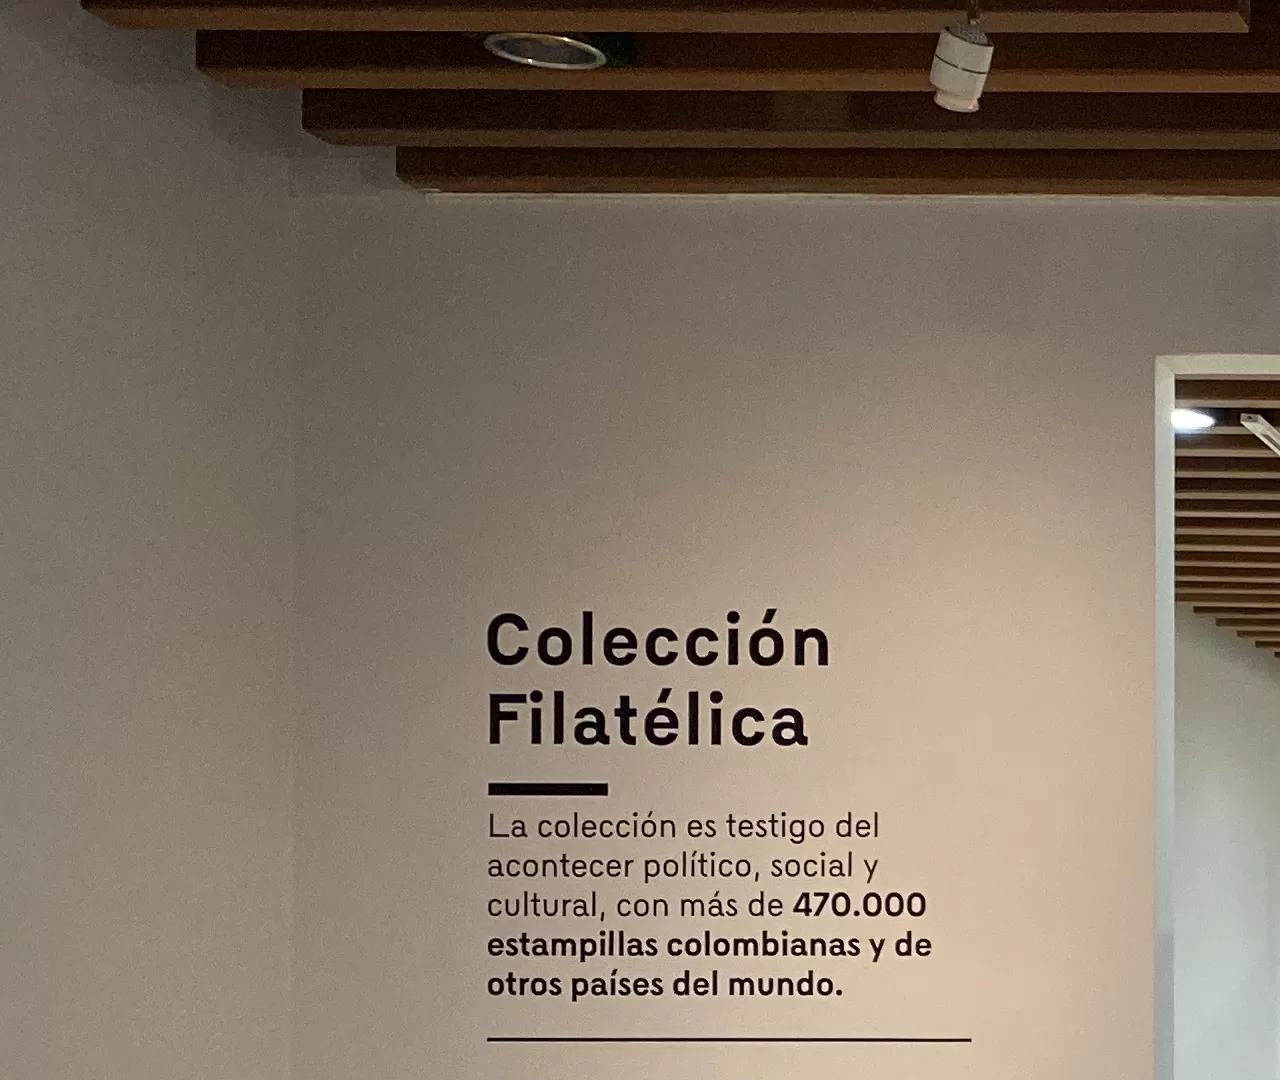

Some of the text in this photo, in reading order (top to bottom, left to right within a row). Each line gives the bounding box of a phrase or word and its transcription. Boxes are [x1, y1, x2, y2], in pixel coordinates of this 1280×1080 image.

[487, 607, 829, 667] Colección
[489, 687, 809, 747] Filatélica
[489, 810, 879, 845] La colección es testigo del
[487, 849, 879, 885] acontecer político, social y
[487, 890, 927, 922] cultural, con más de 470.000
[487, 929, 933, 964] estampillas colombianas y de
[487, 967, 843, 1003] otros países del mundo.
